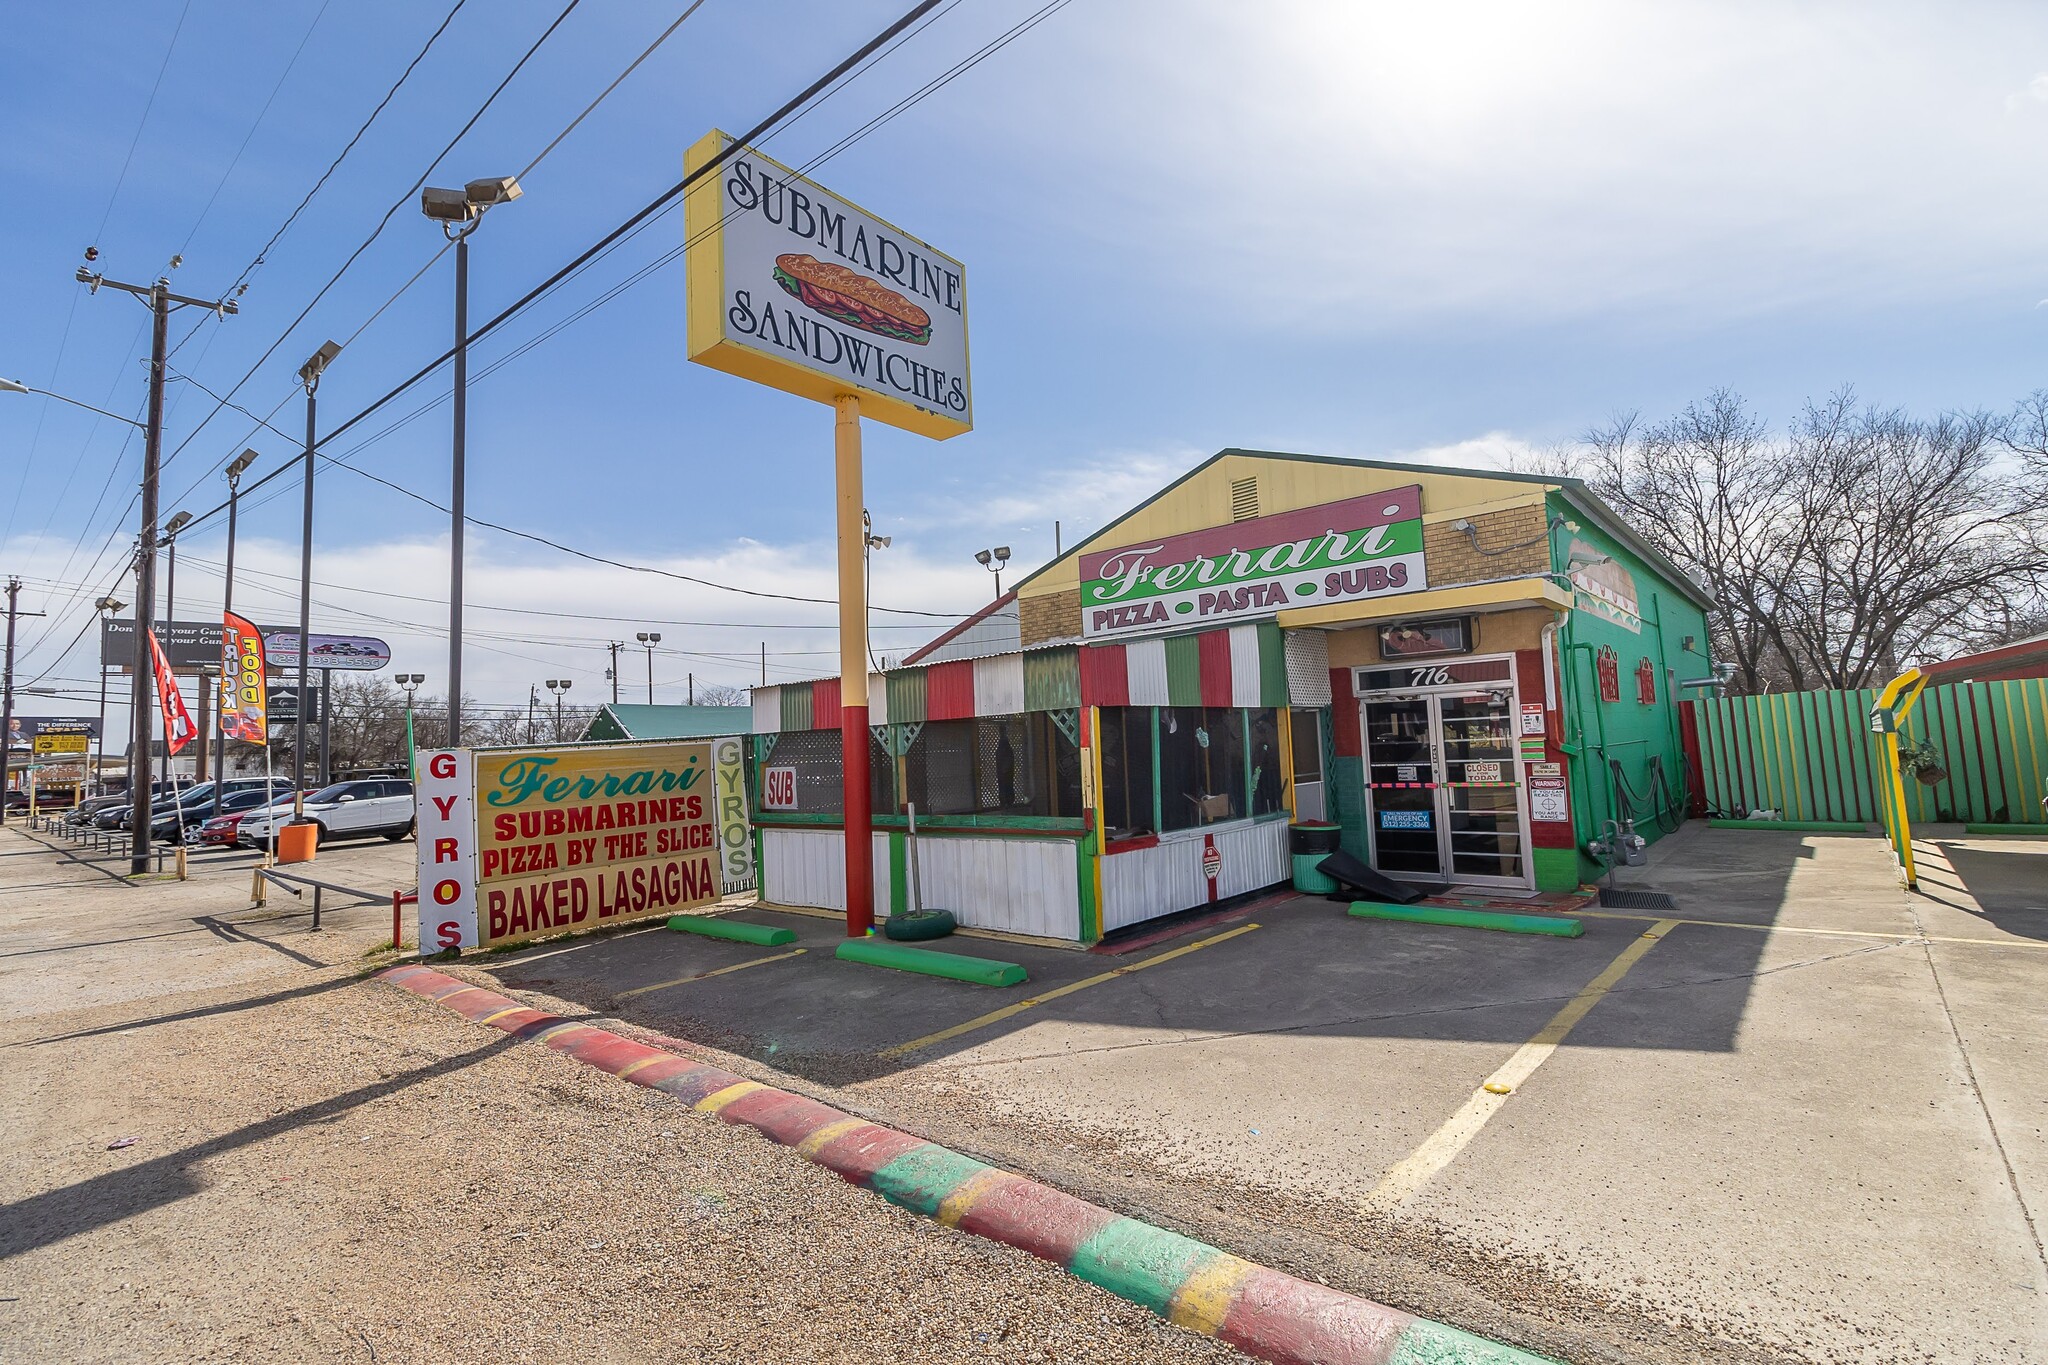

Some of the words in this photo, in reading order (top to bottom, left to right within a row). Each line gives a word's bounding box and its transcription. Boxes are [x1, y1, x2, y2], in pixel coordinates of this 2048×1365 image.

[727, 160, 962, 316] SUBMARINE
[728, 289, 967, 412] SANDWICHES
[1092, 503, 1401, 599] Ferrari
[1092, 600, 1170, 631] PIZZA
[1198, 581, 1289, 615] PASTA
[1324, 562, 1408, 597] SUBS
[170, 637, 197, 646] your
[171, 628, 197, 636] your
[1411, 665, 1450, 687] 716
[487, 755, 705, 807] Ferrari
[768, 770, 794, 806] SUB
[1466, 763, 1499, 772] CLOSED
[494, 795, 703, 841] SUBMARINES
[717, 741, 748, 876] GYROS
[429, 753, 462, 949] GYROS
[483, 845, 556, 877] PIZZA
[567, 837, 597, 867] BY
[604, 831, 648, 860] THE
[656, 823, 713, 854] SLICE
[488, 876, 589, 939] BAKED
[598, 857, 715, 918] LASAGNA
